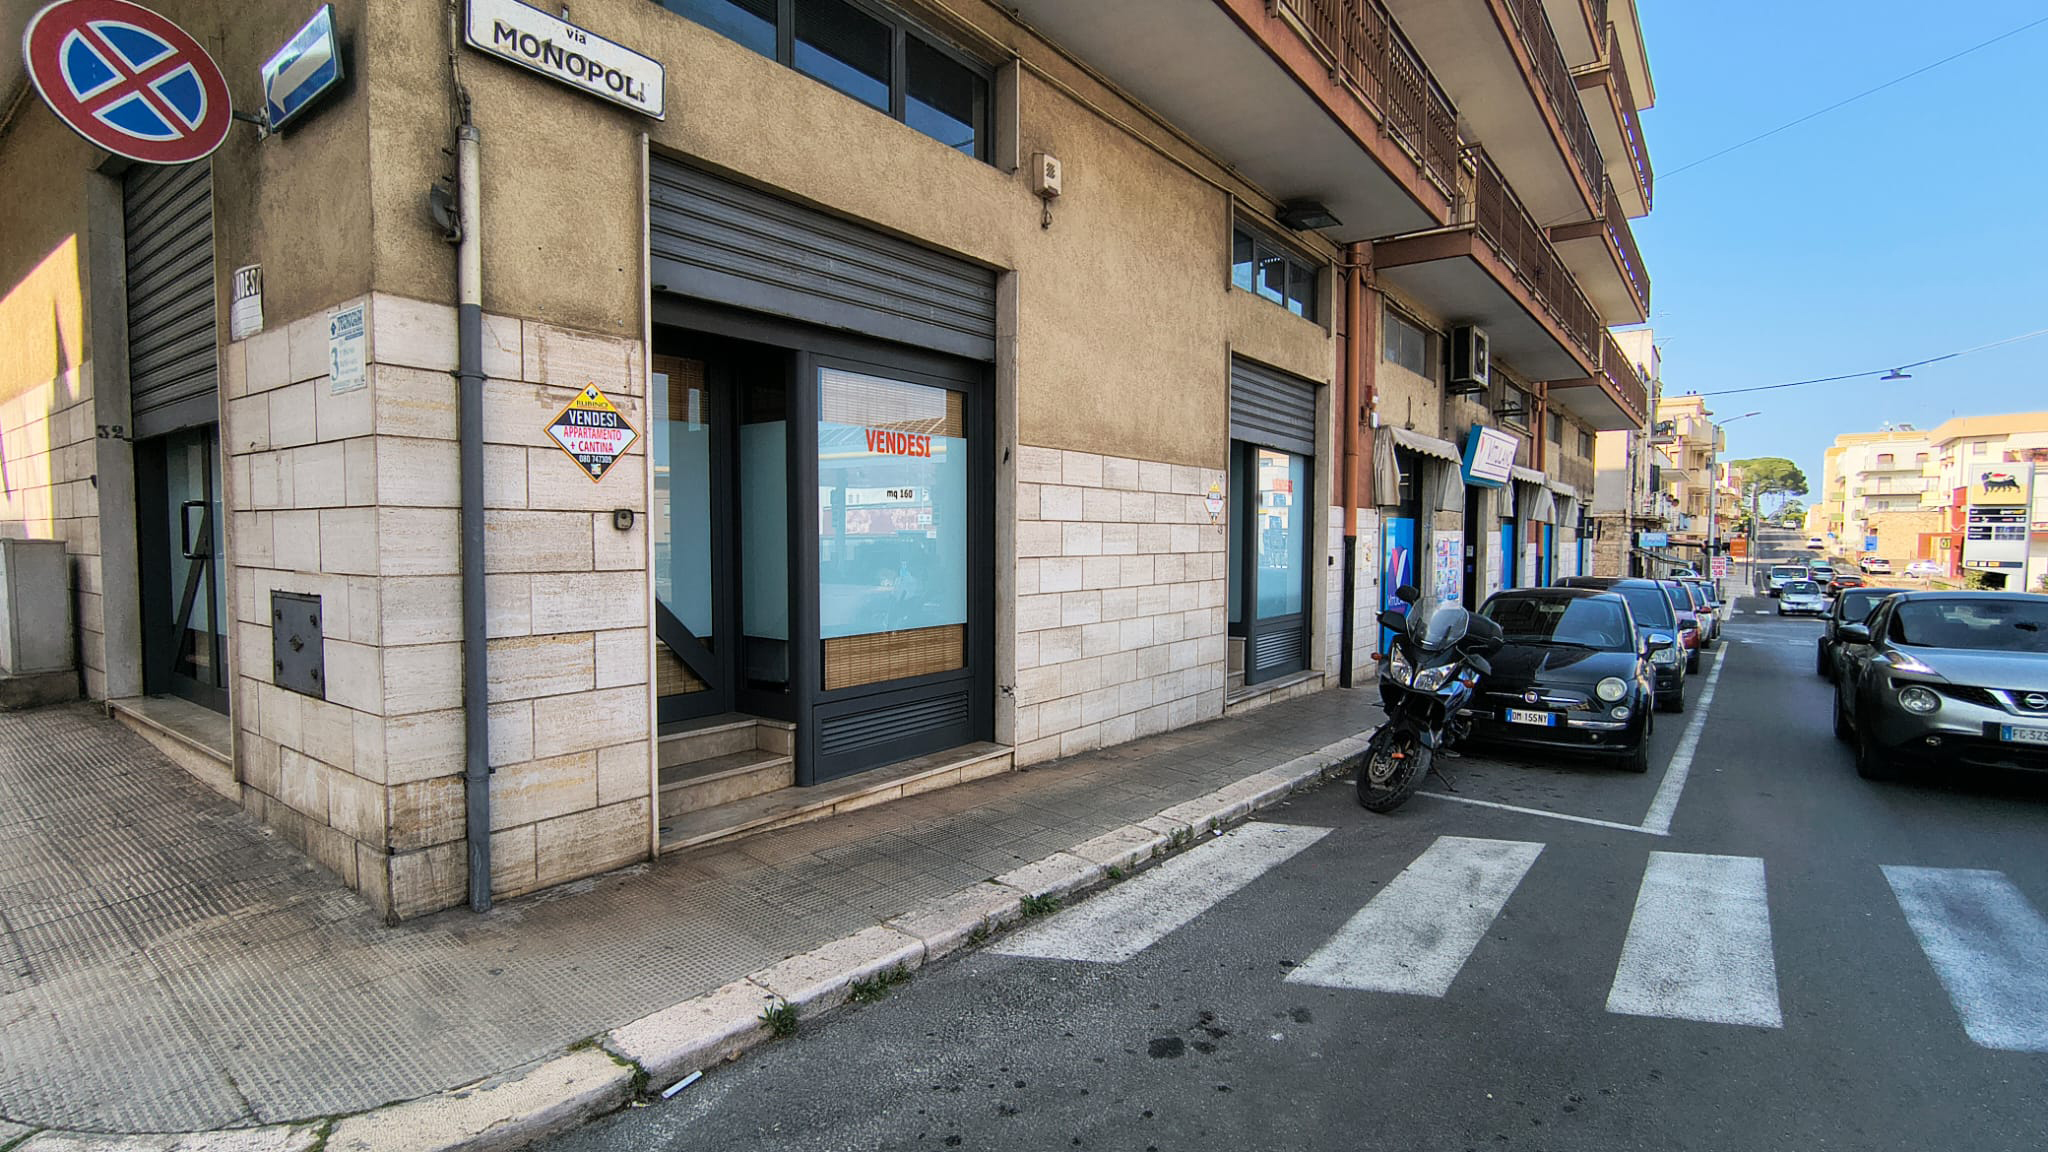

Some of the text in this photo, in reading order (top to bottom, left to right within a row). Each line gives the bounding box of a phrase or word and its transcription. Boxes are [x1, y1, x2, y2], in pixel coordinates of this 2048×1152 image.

[566, 28, 587, 46] via
[493, 20, 647, 104] MONOPOLI
[568, 410, 617, 427] VENDESI
[563, 426, 622, 440] APPARTAMENTO
[578, 441, 614, 453] CANTINA
[865, 428, 931, 458] VENDESI
[887, 489, 913, 499] mq 160
